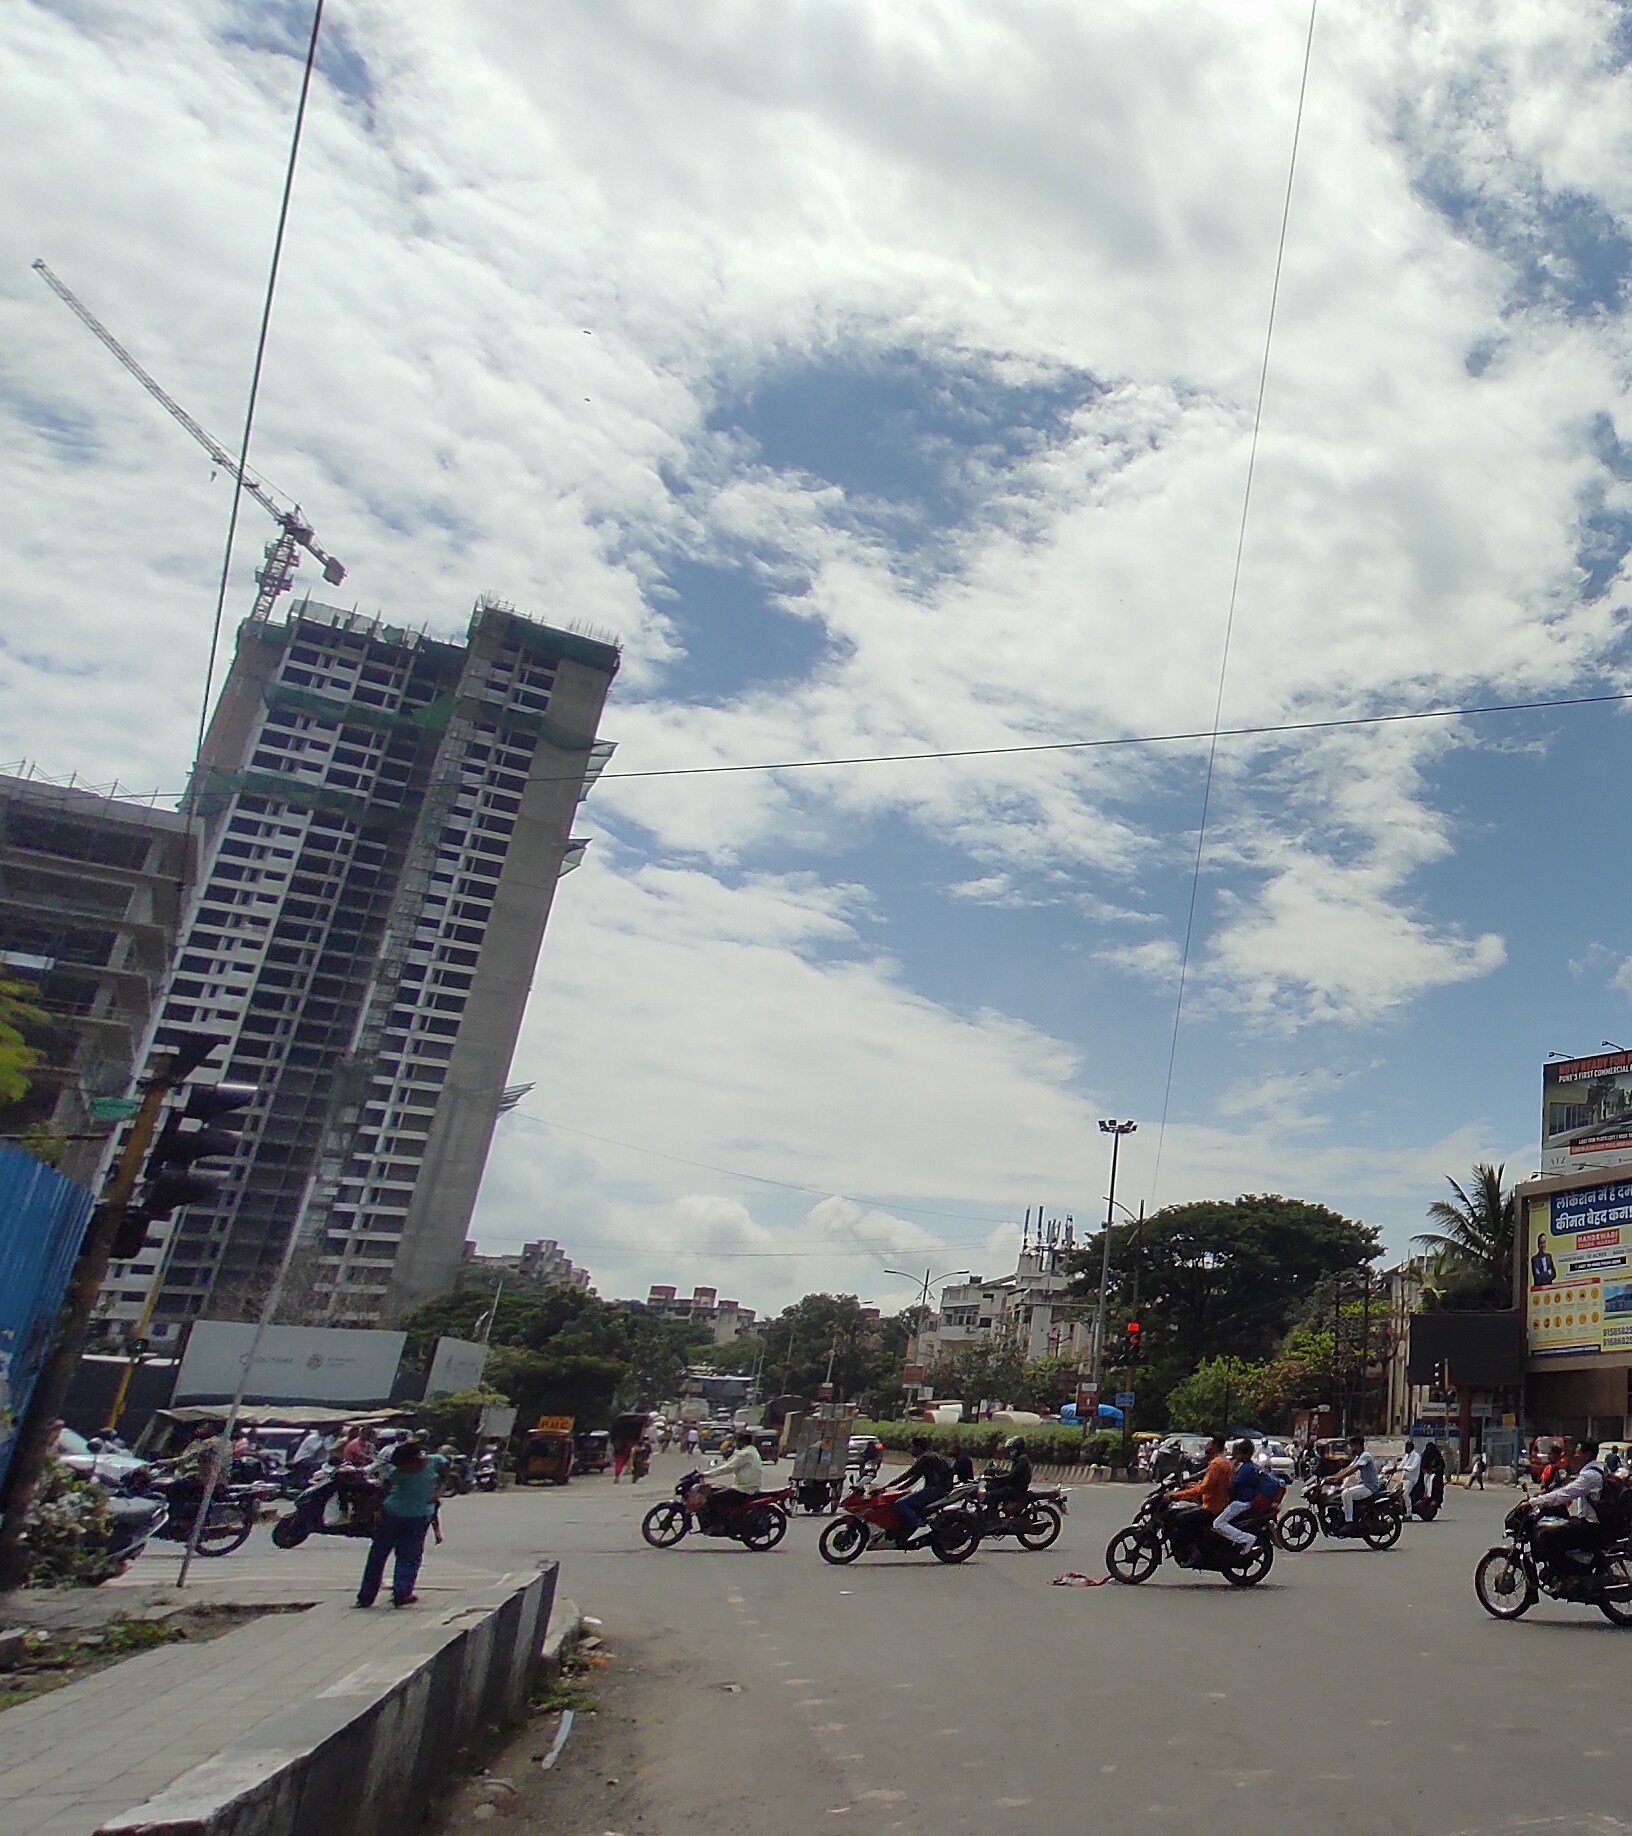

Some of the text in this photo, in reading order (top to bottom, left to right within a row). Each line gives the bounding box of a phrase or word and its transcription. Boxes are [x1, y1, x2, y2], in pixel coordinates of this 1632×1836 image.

[1579, 1070, 1594, 1080] FIRST
[1594, 1065, 1629, 1078] COMMERCIAL
[1581, 1056, 1608, 1073] READY
[1556, 1212, 1585, 1230] कीमत
